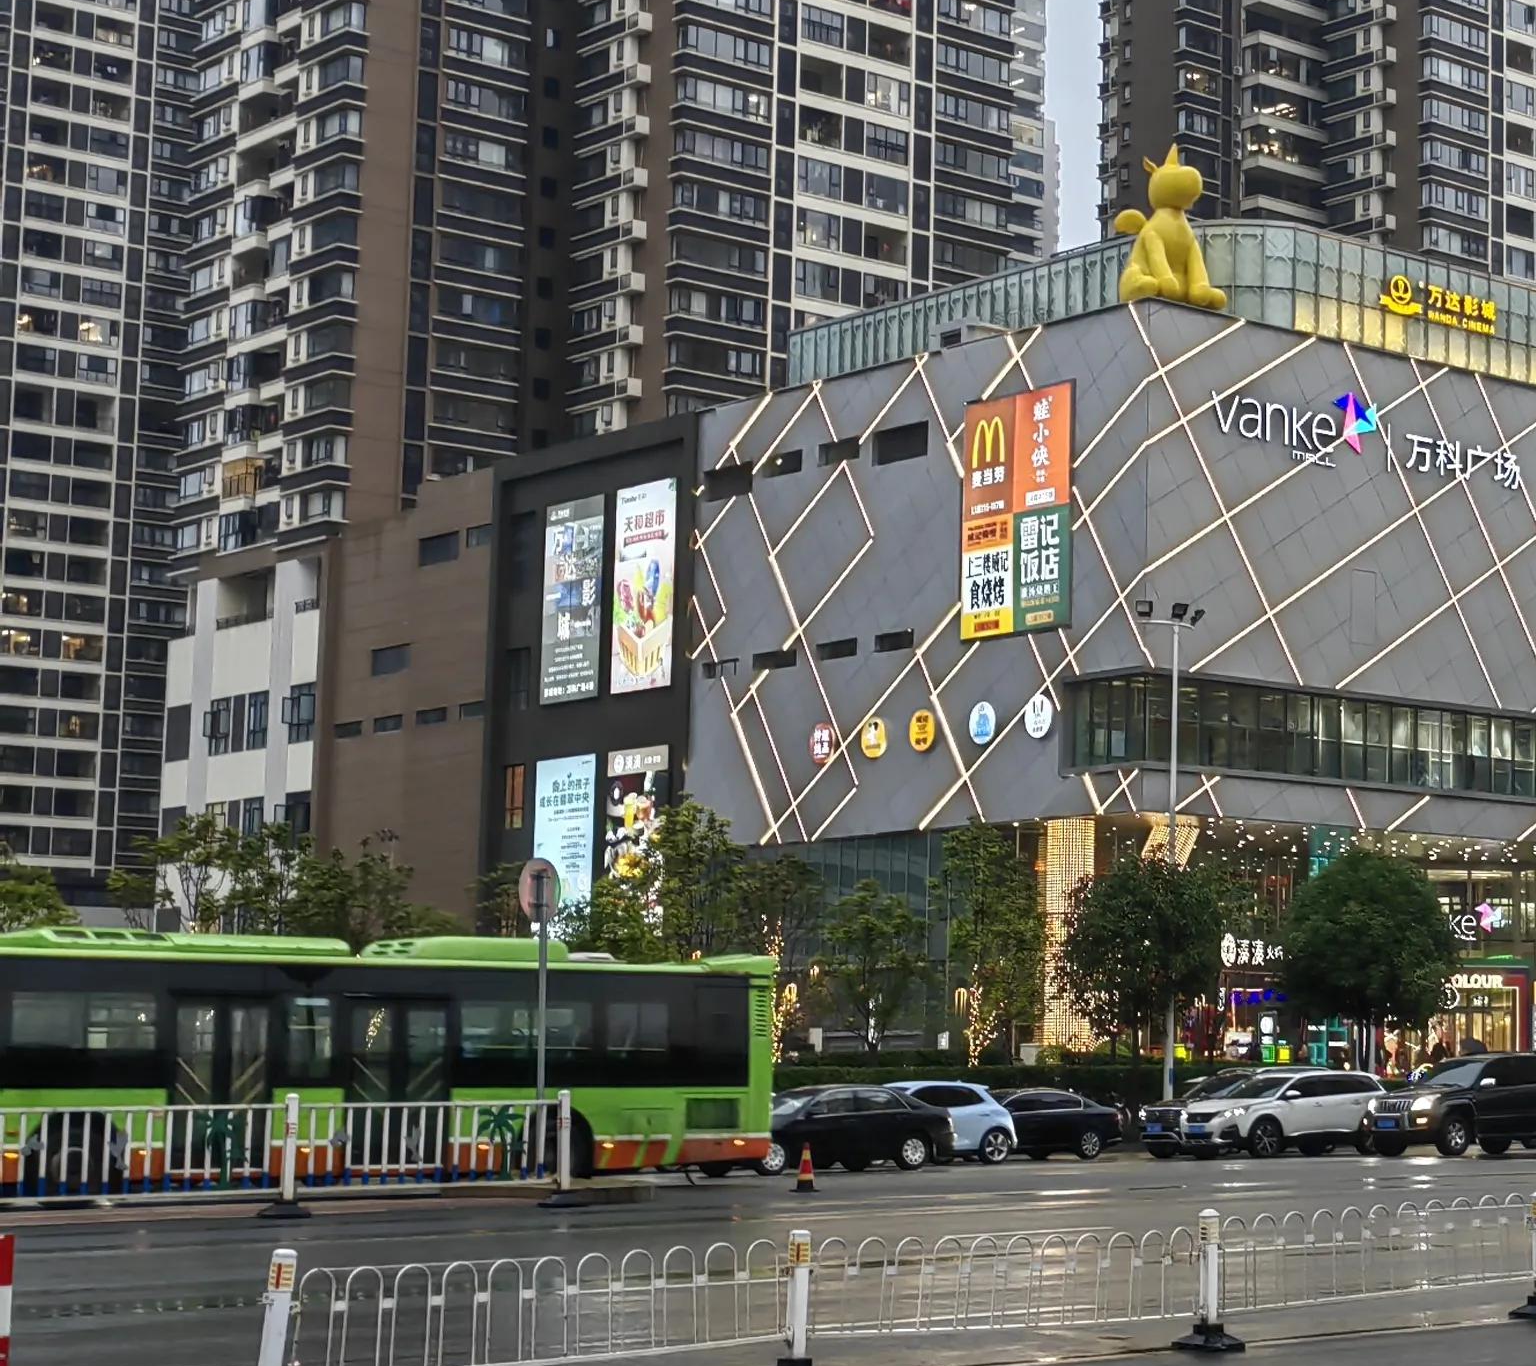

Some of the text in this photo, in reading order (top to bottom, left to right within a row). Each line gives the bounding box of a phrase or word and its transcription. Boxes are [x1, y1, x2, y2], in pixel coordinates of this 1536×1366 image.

[1427, 284, 1496, 321] 万达影城
[1427, 310, 1495, 335] WANDA CINEMA
[1211, 390, 1337, 453] vanke
[972, 466, 1005, 489] 麦当劳
[1406, 433, 1521, 490] 万科广场
[1021, 546, 1060, 584] 饭店
